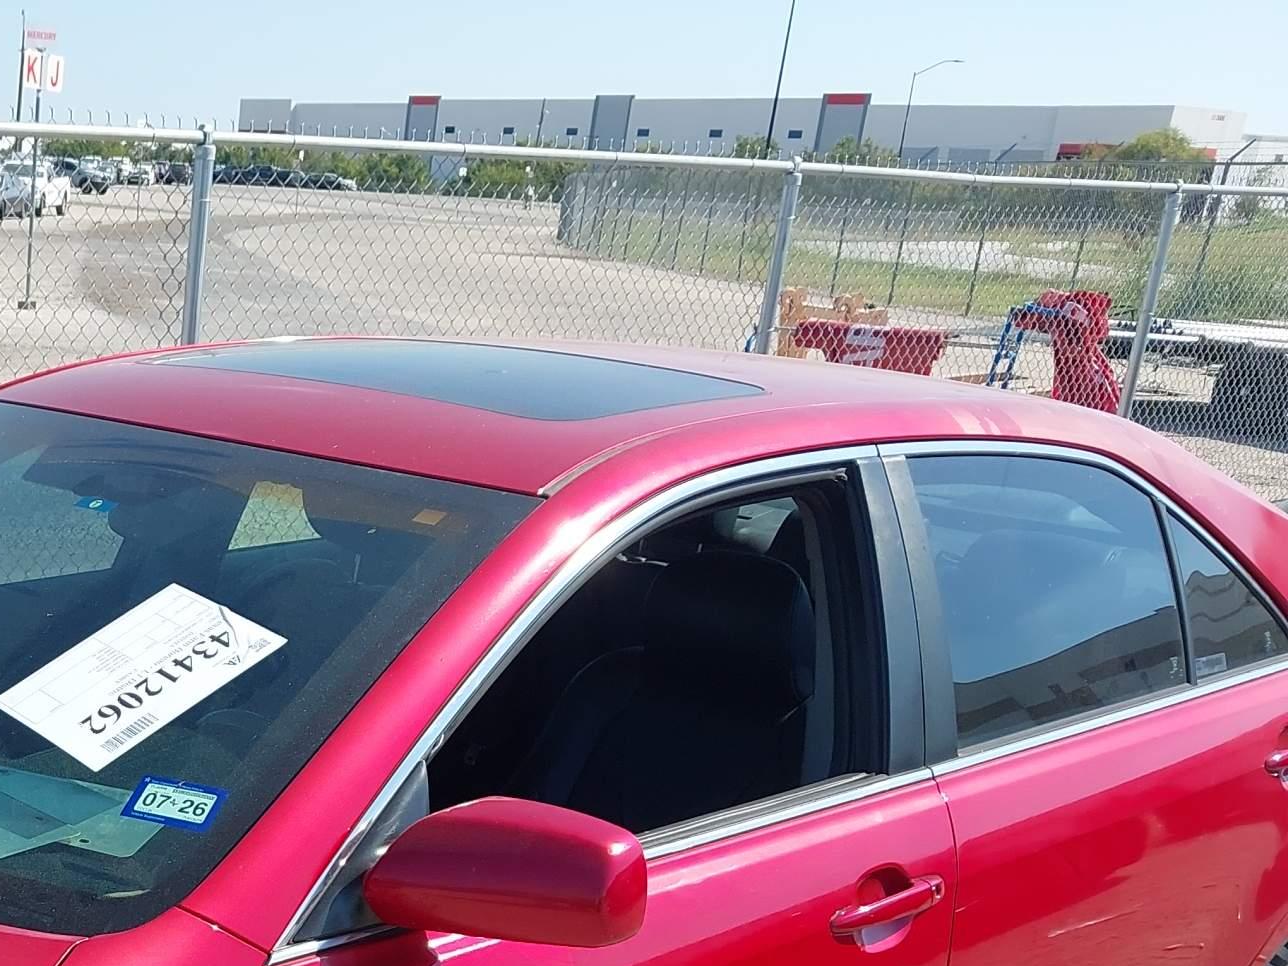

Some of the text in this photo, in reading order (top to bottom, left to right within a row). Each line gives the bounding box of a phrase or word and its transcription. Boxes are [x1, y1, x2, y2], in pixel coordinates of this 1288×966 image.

[26, 55, 38, 83] K
[50, 60, 60, 87] J
[78, 630, 231, 735] 43412062
[142, 792, 172, 809] 07
[177, 799, 209, 817] 26
